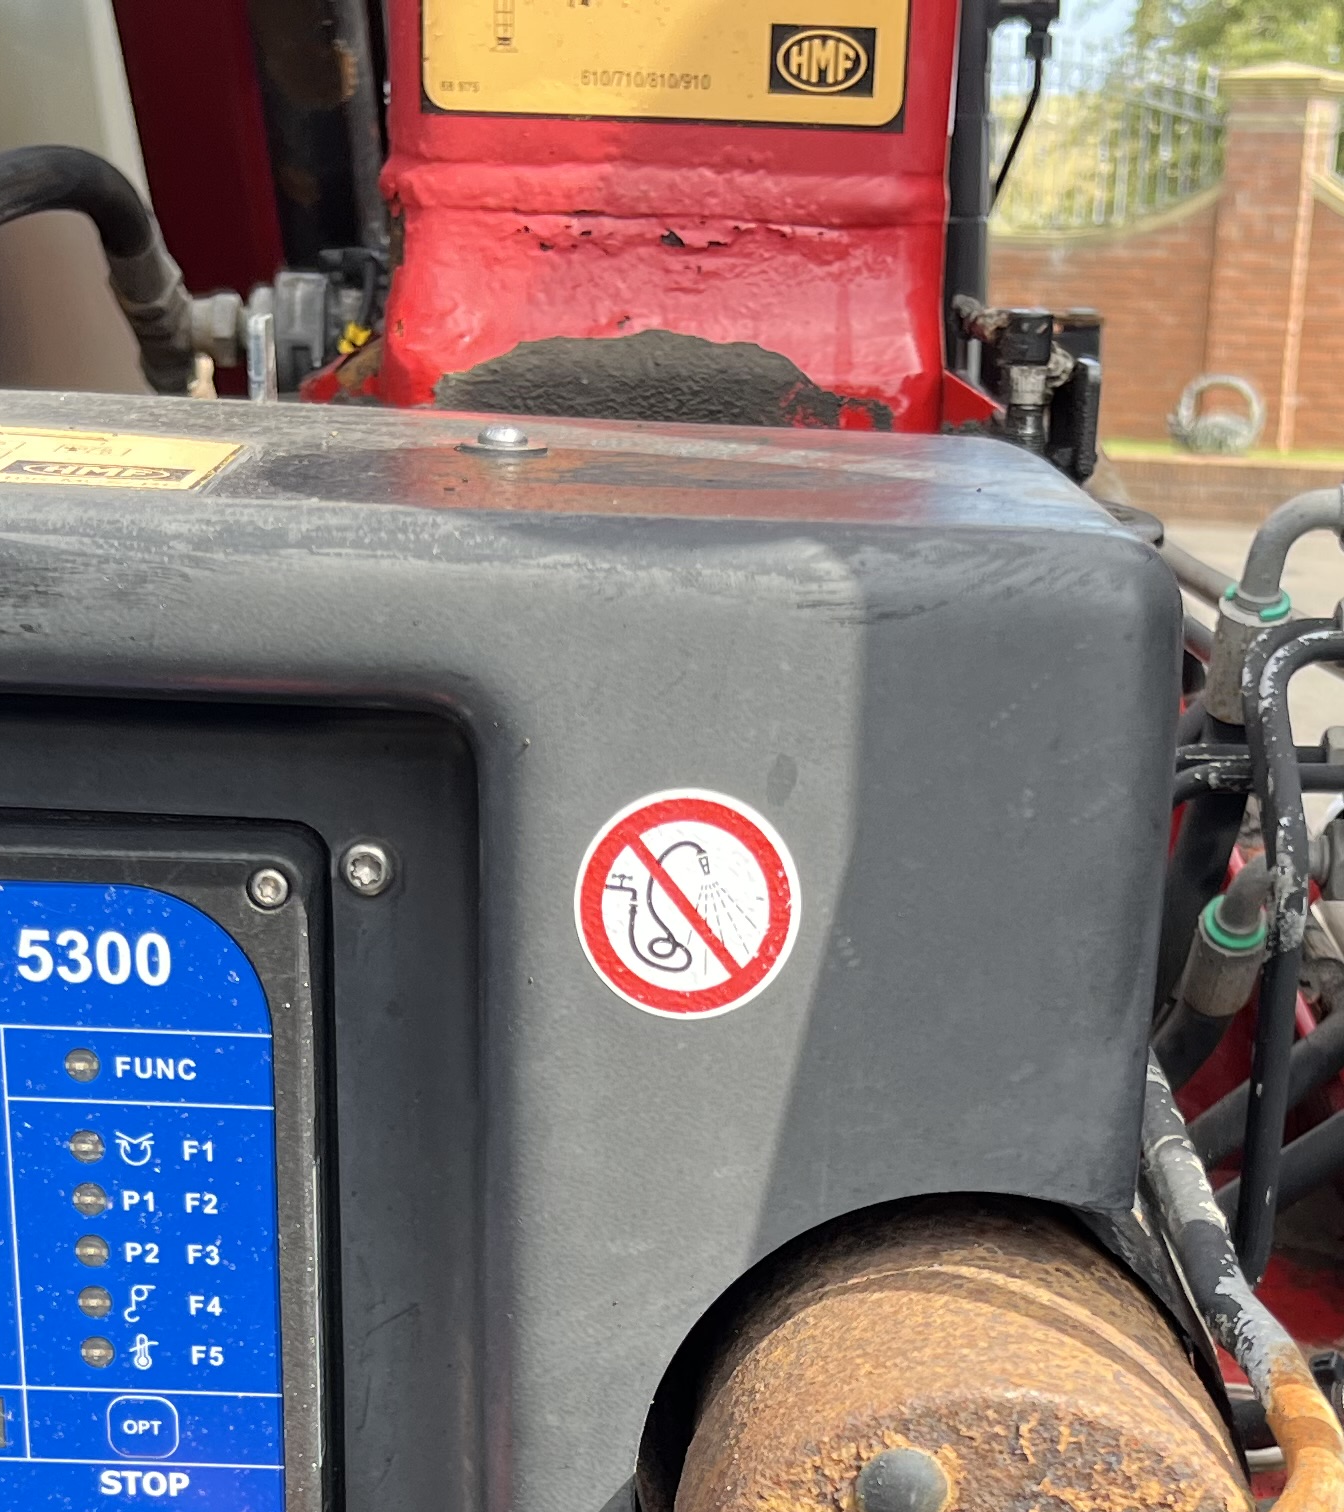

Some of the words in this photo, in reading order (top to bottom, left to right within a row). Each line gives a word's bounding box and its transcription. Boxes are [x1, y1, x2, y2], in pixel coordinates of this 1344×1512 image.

[788, 38, 856, 84] HMF
[42, 464, 154, 478] HMF
[17, 928, 171, 987] 5300
[115, 1056, 197, 1081] FUNC
[183, 1140, 213, 1162] F1
[122, 1190, 155, 1212] P1
[185, 1192, 218, 1214] F2
[125, 1242, 160, 1264] P2
[187, 1244, 220, 1266] F3
[189, 1295, 223, 1316] F4
[191, 1345, 224, 1367] F5
[122, 1419, 162, 1435] OPT
[100, 1469, 190, 1497] STOP
